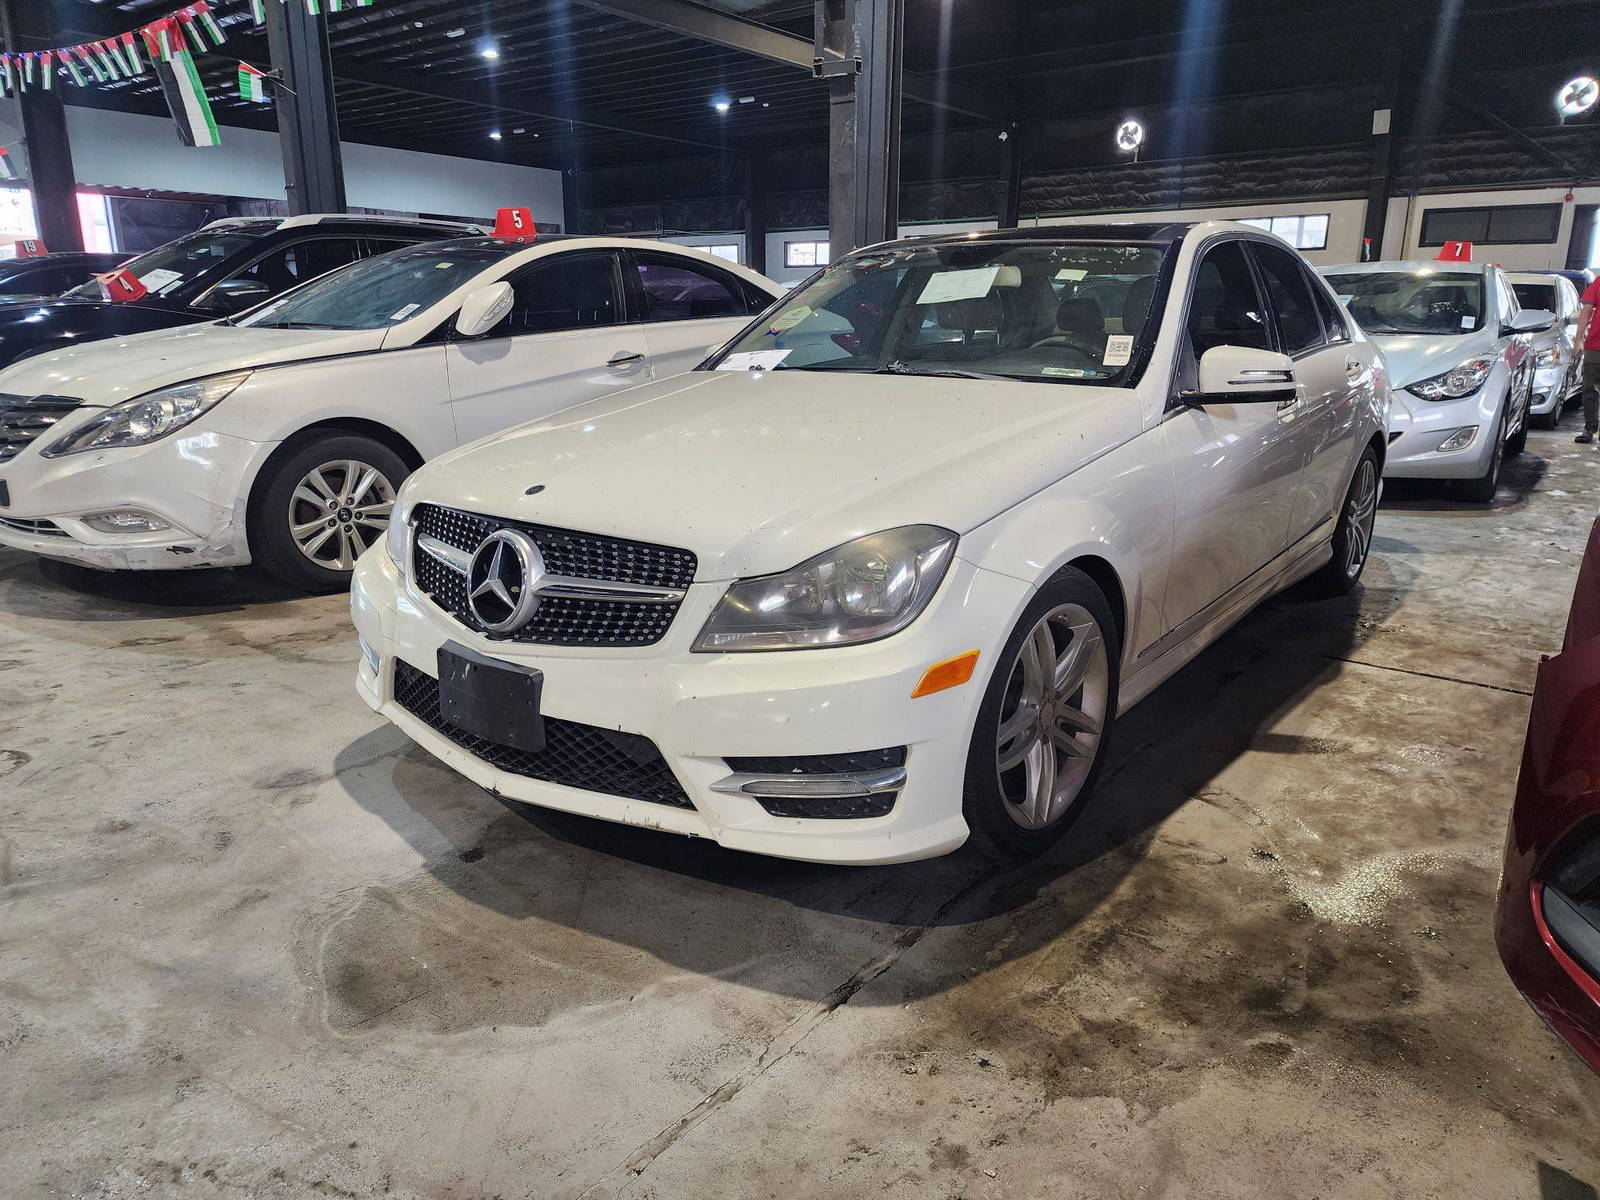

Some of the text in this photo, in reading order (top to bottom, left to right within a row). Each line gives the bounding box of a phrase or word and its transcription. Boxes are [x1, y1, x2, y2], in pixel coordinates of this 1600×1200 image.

[512, 210, 523, 229] 5
[23, 240, 37, 253] 19
[1455, 243, 1463, 257] 7
